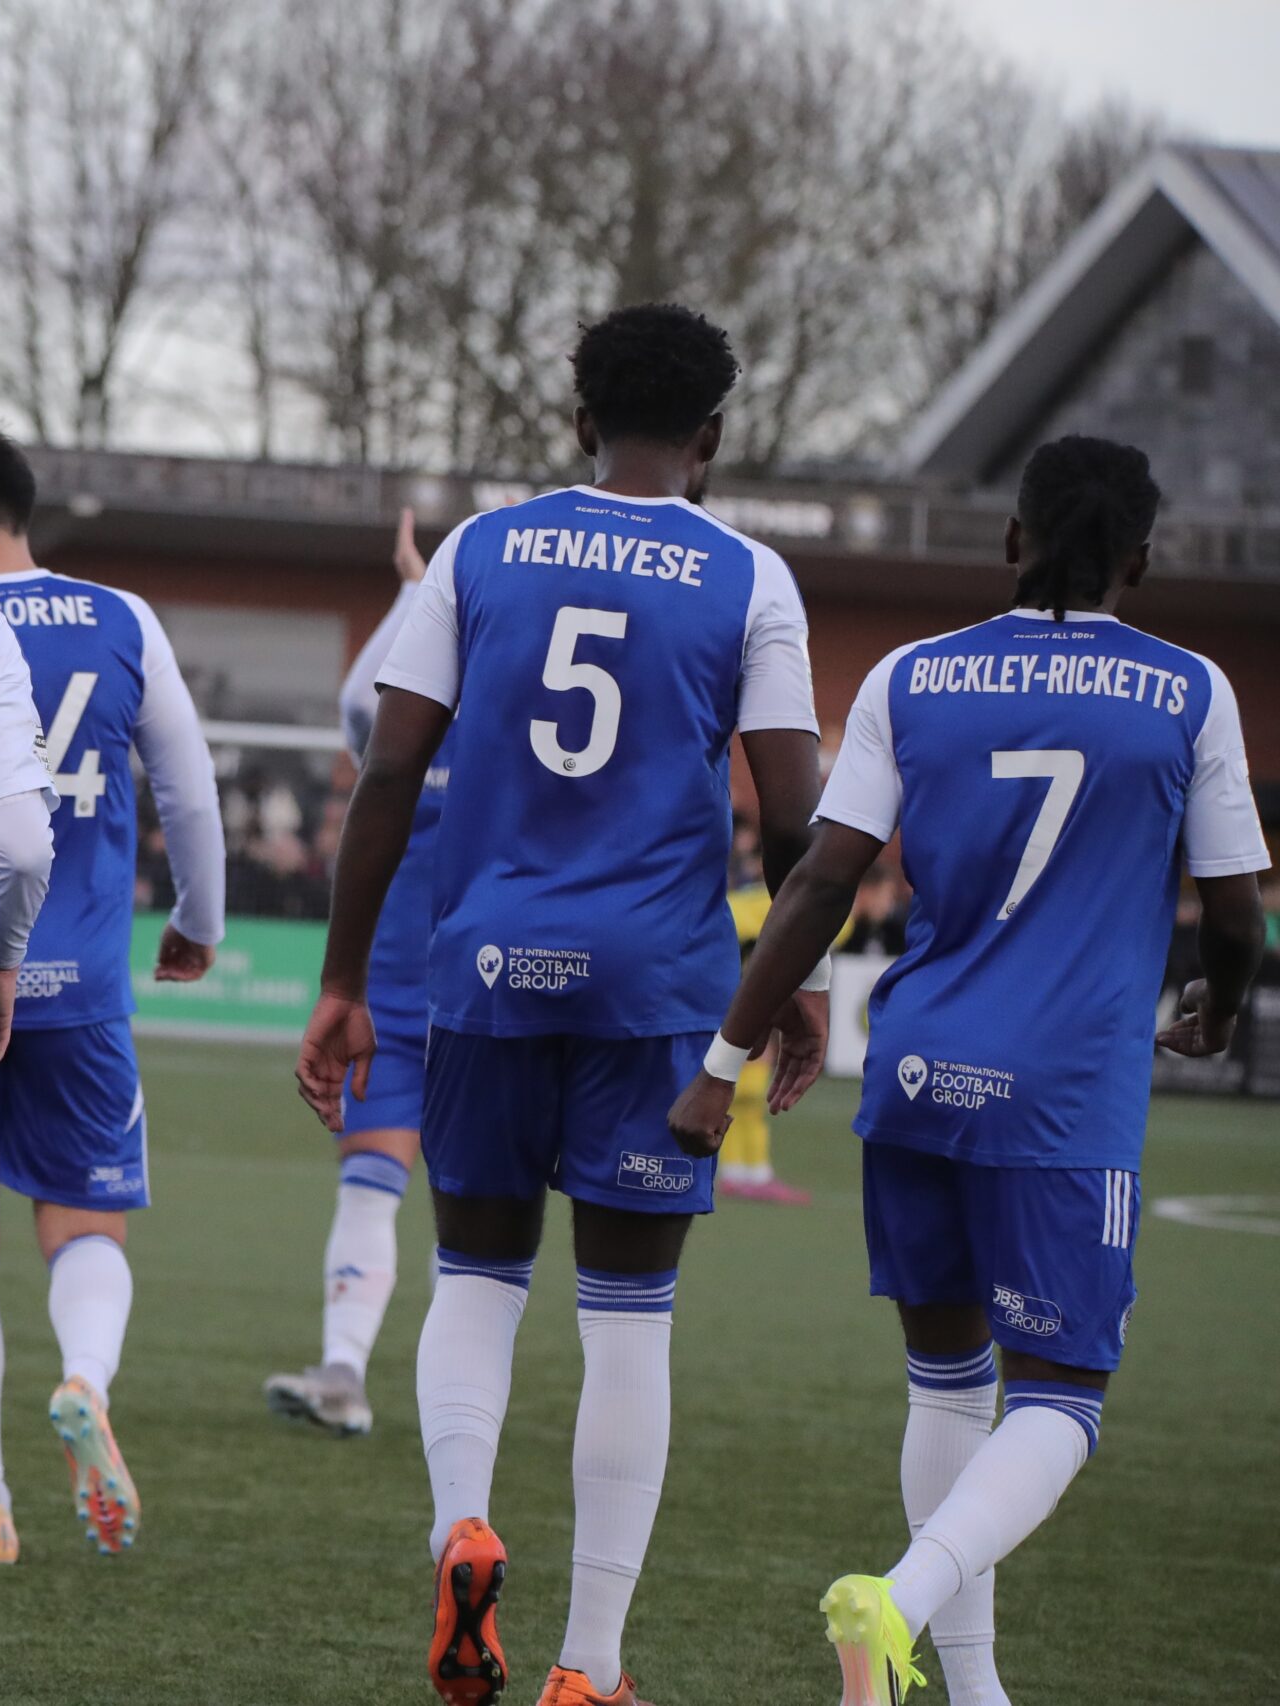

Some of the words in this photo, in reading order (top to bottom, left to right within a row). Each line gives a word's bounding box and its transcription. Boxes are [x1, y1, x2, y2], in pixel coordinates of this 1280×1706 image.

[502, 528, 709, 587] MENAYESE
[530, 606, 628, 778] 5
[909, 654, 1188, 715] BUCKLEY-RICKETTS
[991, 749, 1085, 921] 7
[508, 947, 523, 956] THE
[525, 948, 591, 960] INTERNATIONAL
[17, 969, 80, 984] OOTBALL
[508, 958, 590, 977] FOOTBALL
[508, 974, 568, 990] GROUP
[933, 1060, 948, 1070] THE
[949, 1063, 1014, 1081] INTERNATIONAL
[932, 1072, 1011, 1099] FOOTBALL
[932, 1088, 985, 1110] GROUP
[623, 1155, 663, 1175] JBSi
[642, 1175, 690, 1190] GROUP
[993, 1287, 1025, 1311] JBSi
[1006, 1310, 1056, 1333] GROUP
